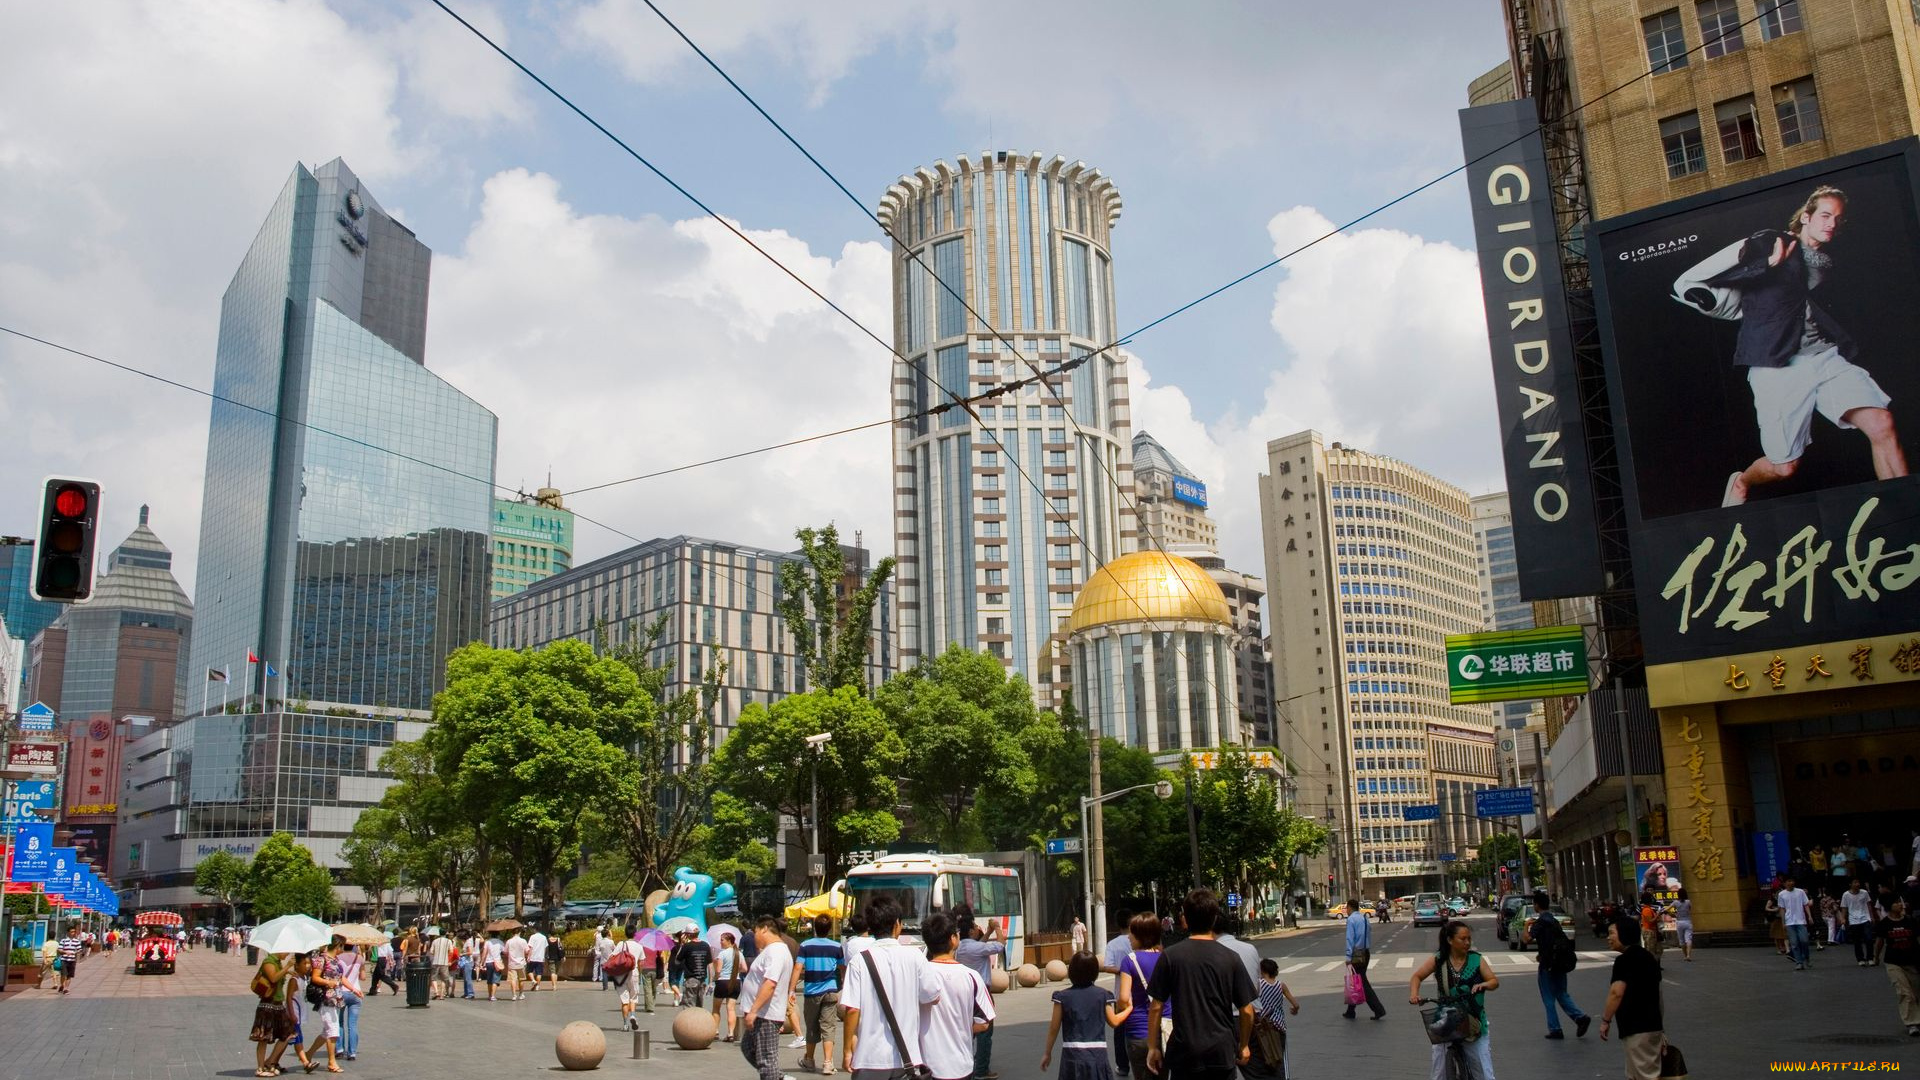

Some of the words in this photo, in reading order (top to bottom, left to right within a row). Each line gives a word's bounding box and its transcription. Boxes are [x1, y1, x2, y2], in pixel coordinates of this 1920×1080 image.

[1619, 235, 1698, 260] GIORDANO
[1633, 244, 1688, 262] e-giordano.com
[1487, 164, 1569, 522] GIORDANO
[1489, 650, 1575, 676] 华联超市
[198, 844, 222, 855] Hotel
[226, 843, 255, 854] Sofitel
[1639, 850, 1676, 860] 反季特卖
